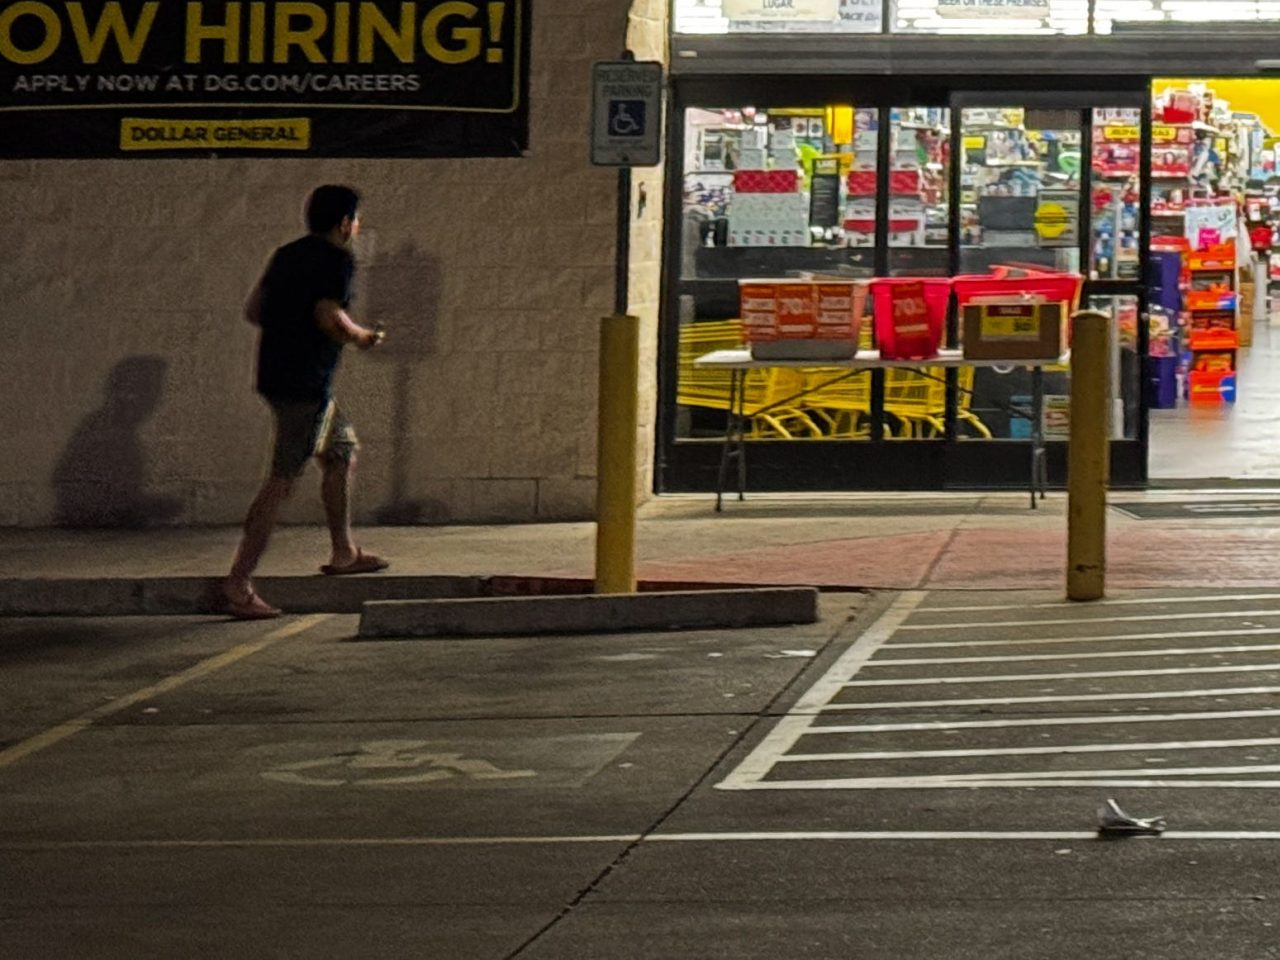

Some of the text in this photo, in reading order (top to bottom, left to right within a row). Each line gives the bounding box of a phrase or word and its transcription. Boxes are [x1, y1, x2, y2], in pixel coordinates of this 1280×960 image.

[0, 0, 505, 65] OW HIRING!
[13, 73, 421, 93] APPLY NOW AT DG.COM/CAREERS
[131, 127, 299, 141] DOLLAR GENERAL
